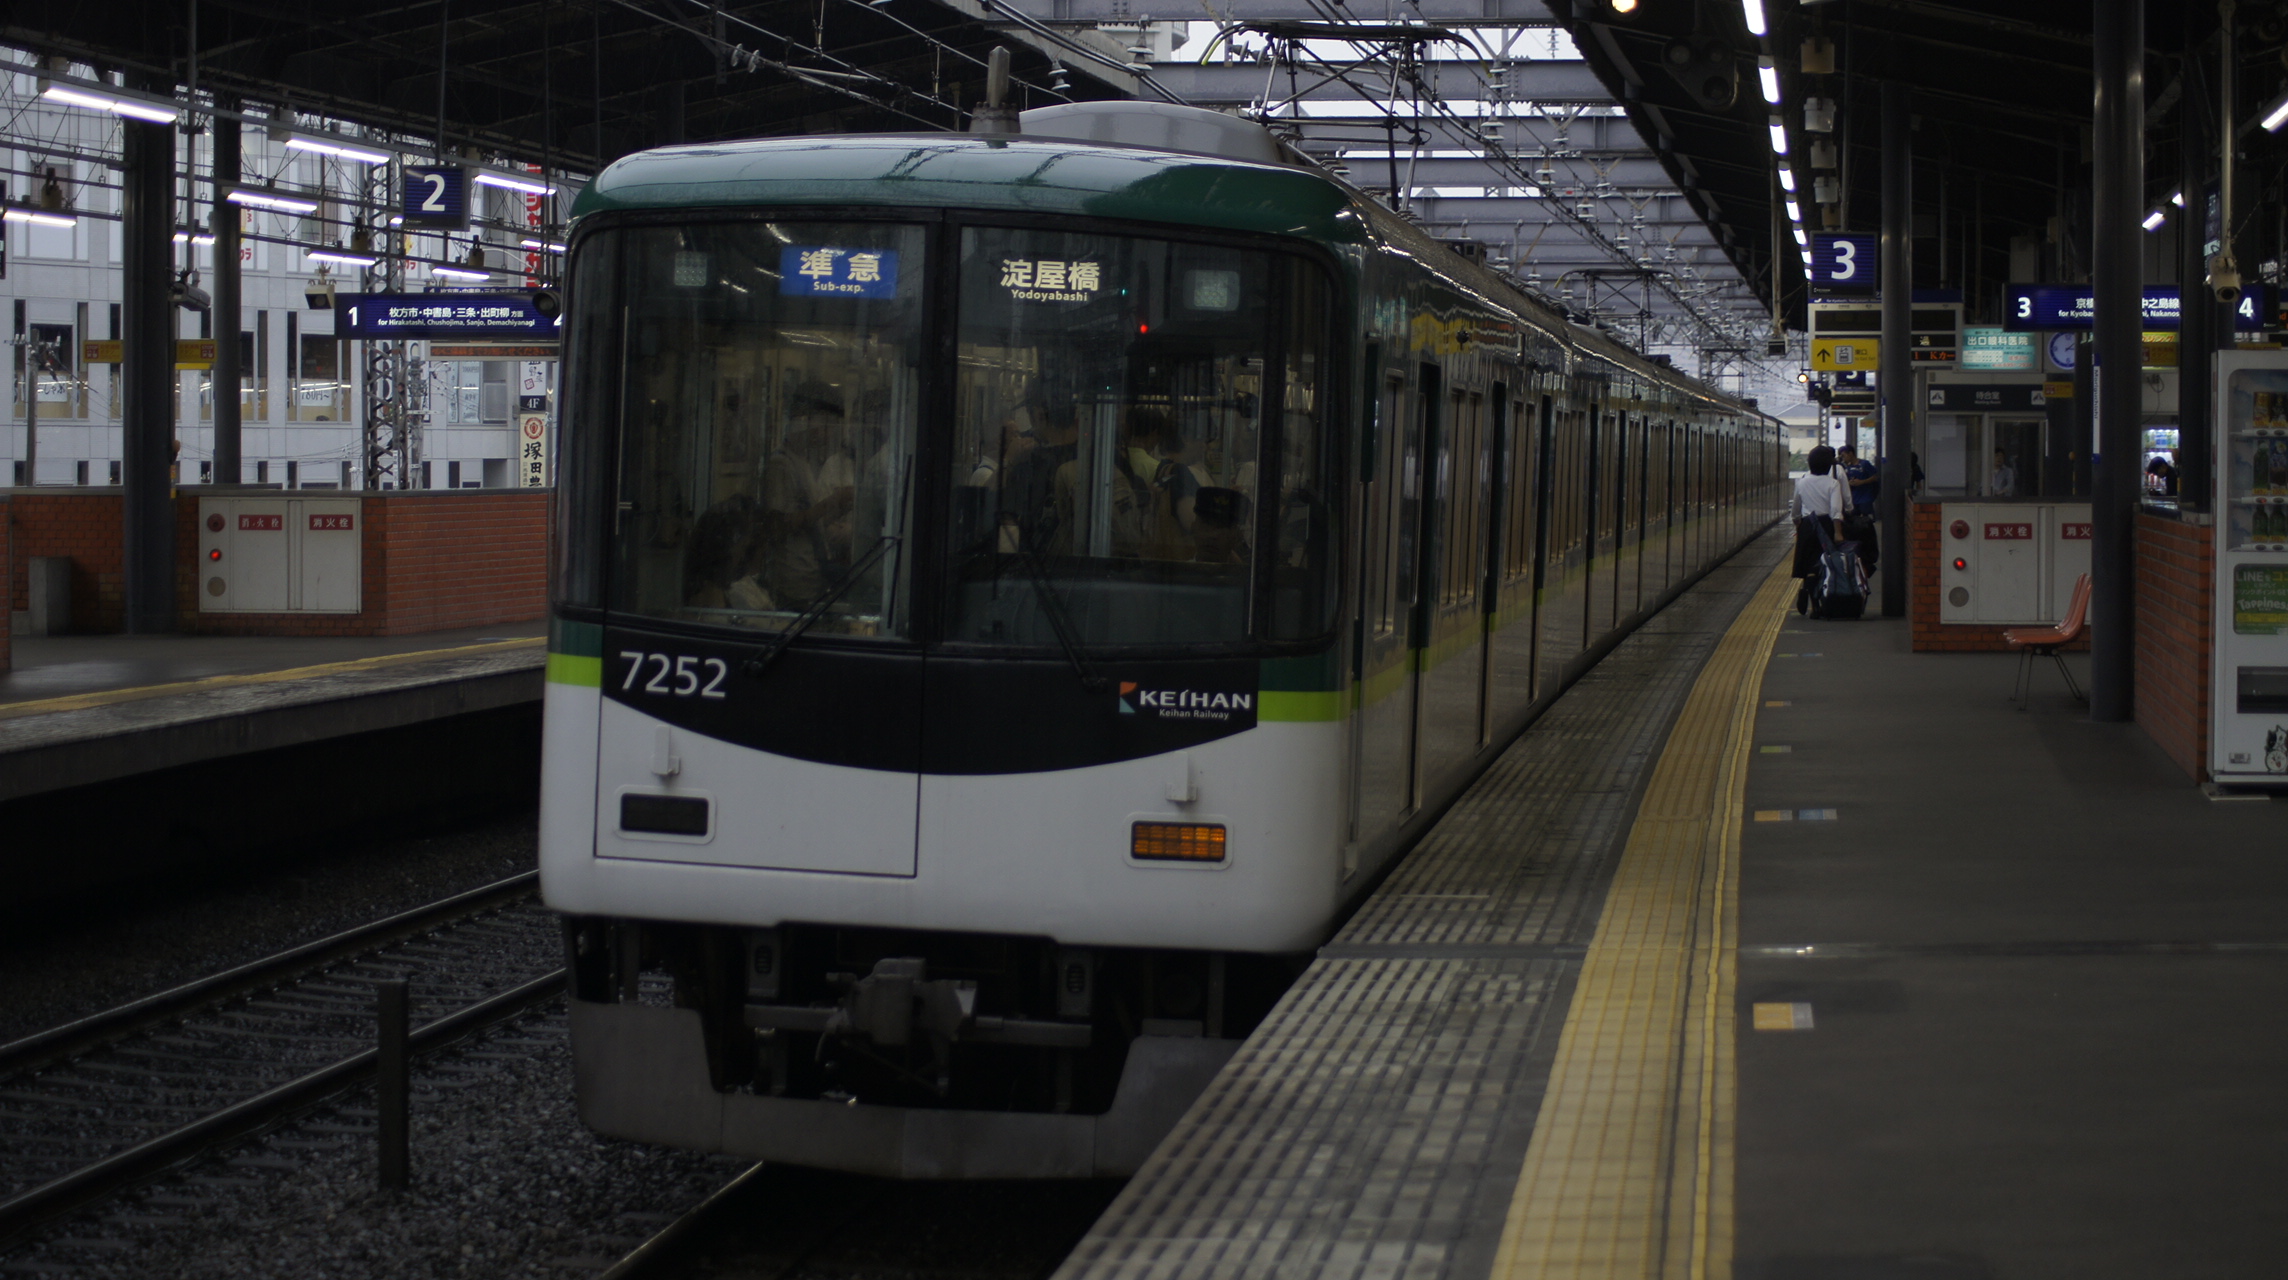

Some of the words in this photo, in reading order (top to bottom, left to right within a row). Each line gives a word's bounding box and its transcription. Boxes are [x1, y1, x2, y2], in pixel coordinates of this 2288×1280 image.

[422, 174, 446, 212] 2
[799, 250, 881, 282] 準急
[1831, 240, 1856, 280] 3
[1000, 258, 1100, 291] 淀屋橋
[813, 281, 865, 294] Sub-exp.
[1011, 289, 1088, 302] Yodoyabashi
[348, 306, 358, 326] 1
[2017, 296, 2031, 318] 3
[2238, 296, 2254, 318] 4
[377, 318, 388, 326] for
[388, 318, 426, 327] Hirakatashi,
[427, 318, 465, 328] Chushojima,
[466, 318, 486, 328] Sanjo,
[487, 318, 536, 328] Demachiyanagi
[527, 397, 540, 409] 4F
[313, 517, 349, 528] 消火栓
[1988, 526, 2028, 537] 消火栓
[619, 650, 728, 698] 7252
[1139, 688, 1251, 709] KEIHAN
[1159, 708, 1191, 718] Keihan
[1193, 709, 1230, 721] Railway
